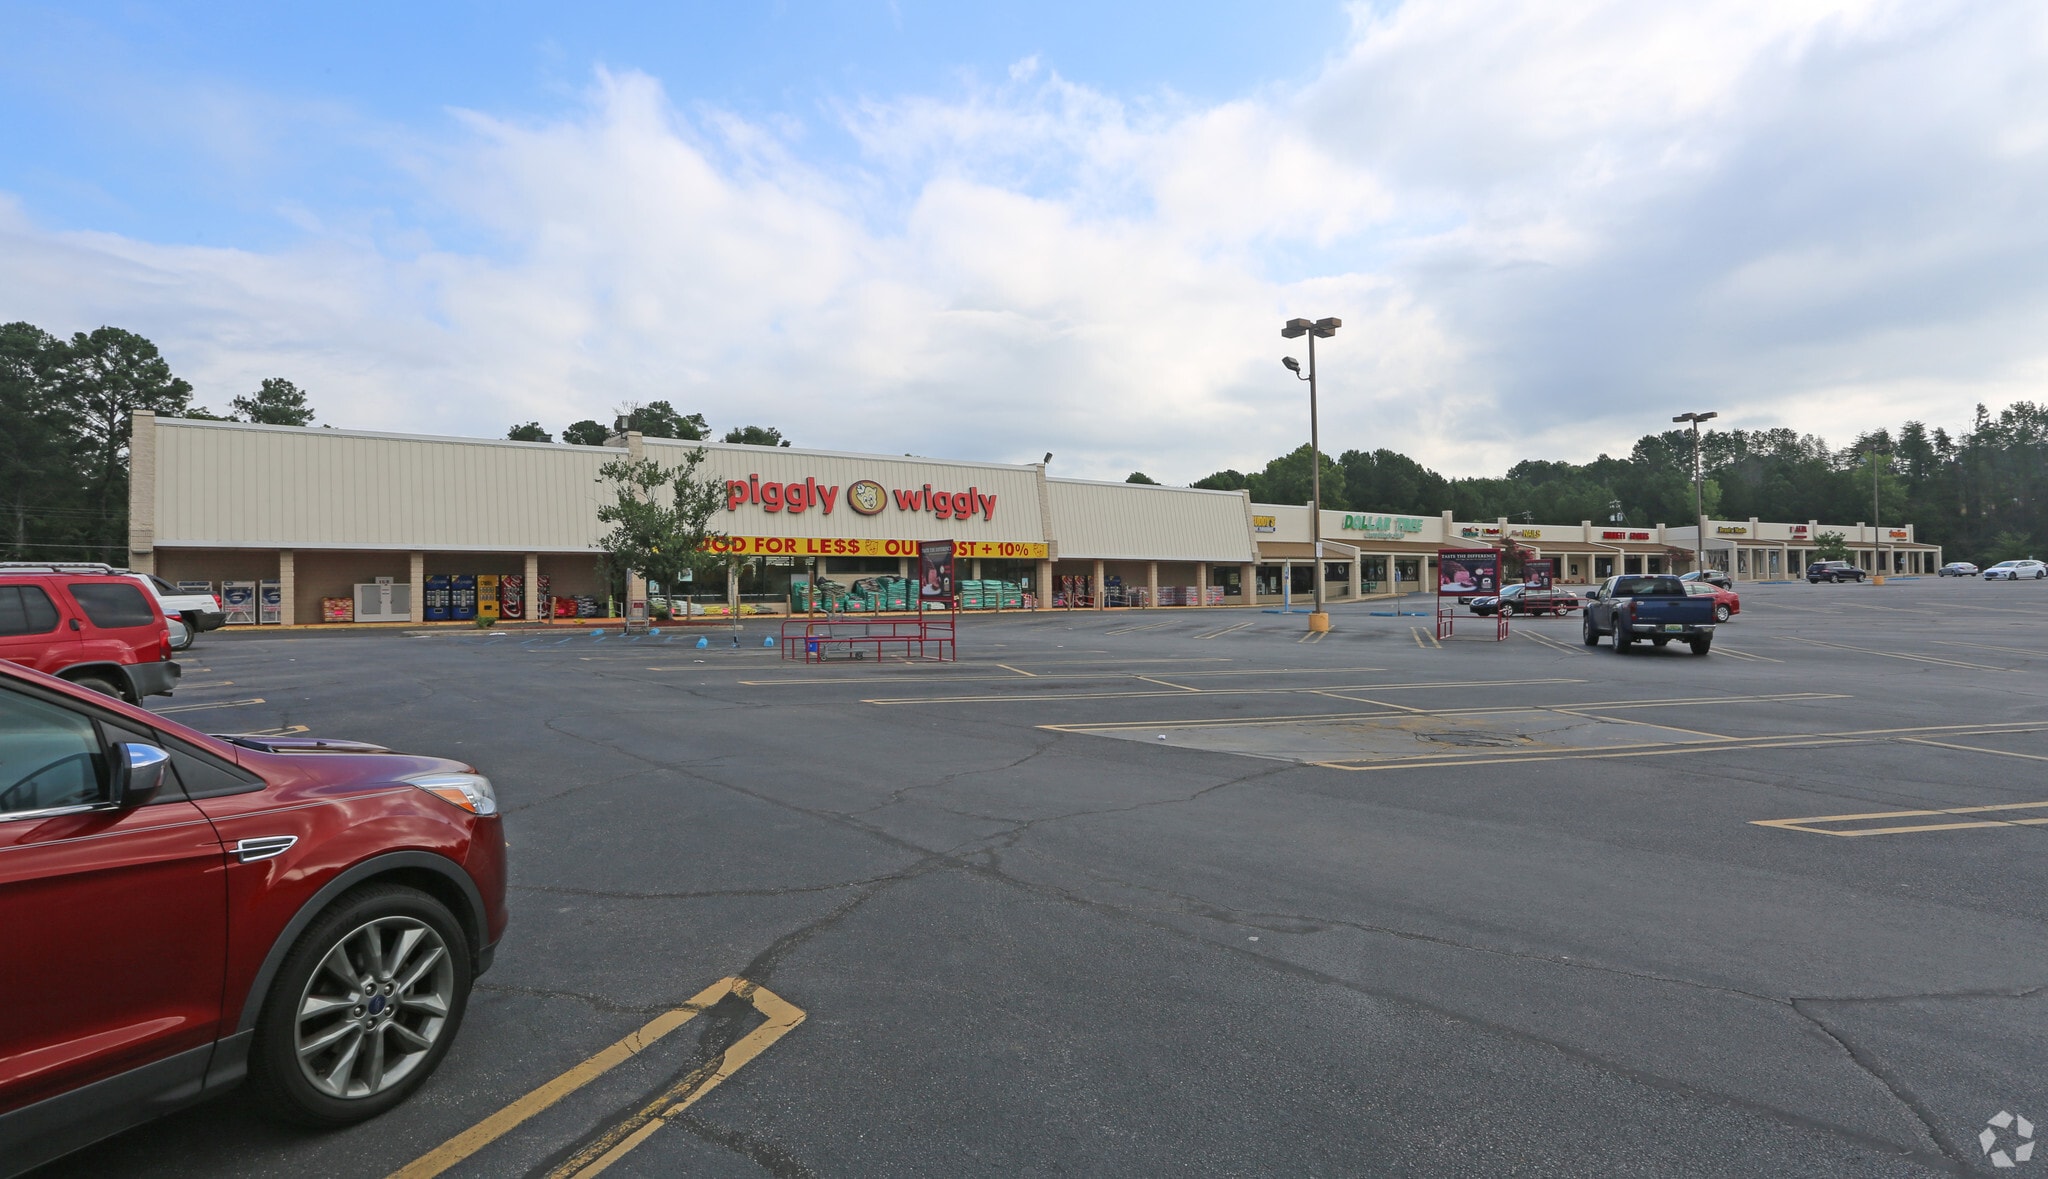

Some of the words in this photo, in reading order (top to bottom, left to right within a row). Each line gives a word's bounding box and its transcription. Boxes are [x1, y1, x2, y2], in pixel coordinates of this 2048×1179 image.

[726, 474, 839, 514] piggly
[894, 483, 997, 521] wiggly
[1343, 514, 1391, 531] DOLLAR
[1395, 518, 1423, 532] TREE
[754, 537, 797, 553] FOR
[807, 538, 860, 555] LE$$
[982, 543, 992, 554] +
[997, 542, 1029, 557] 10%
